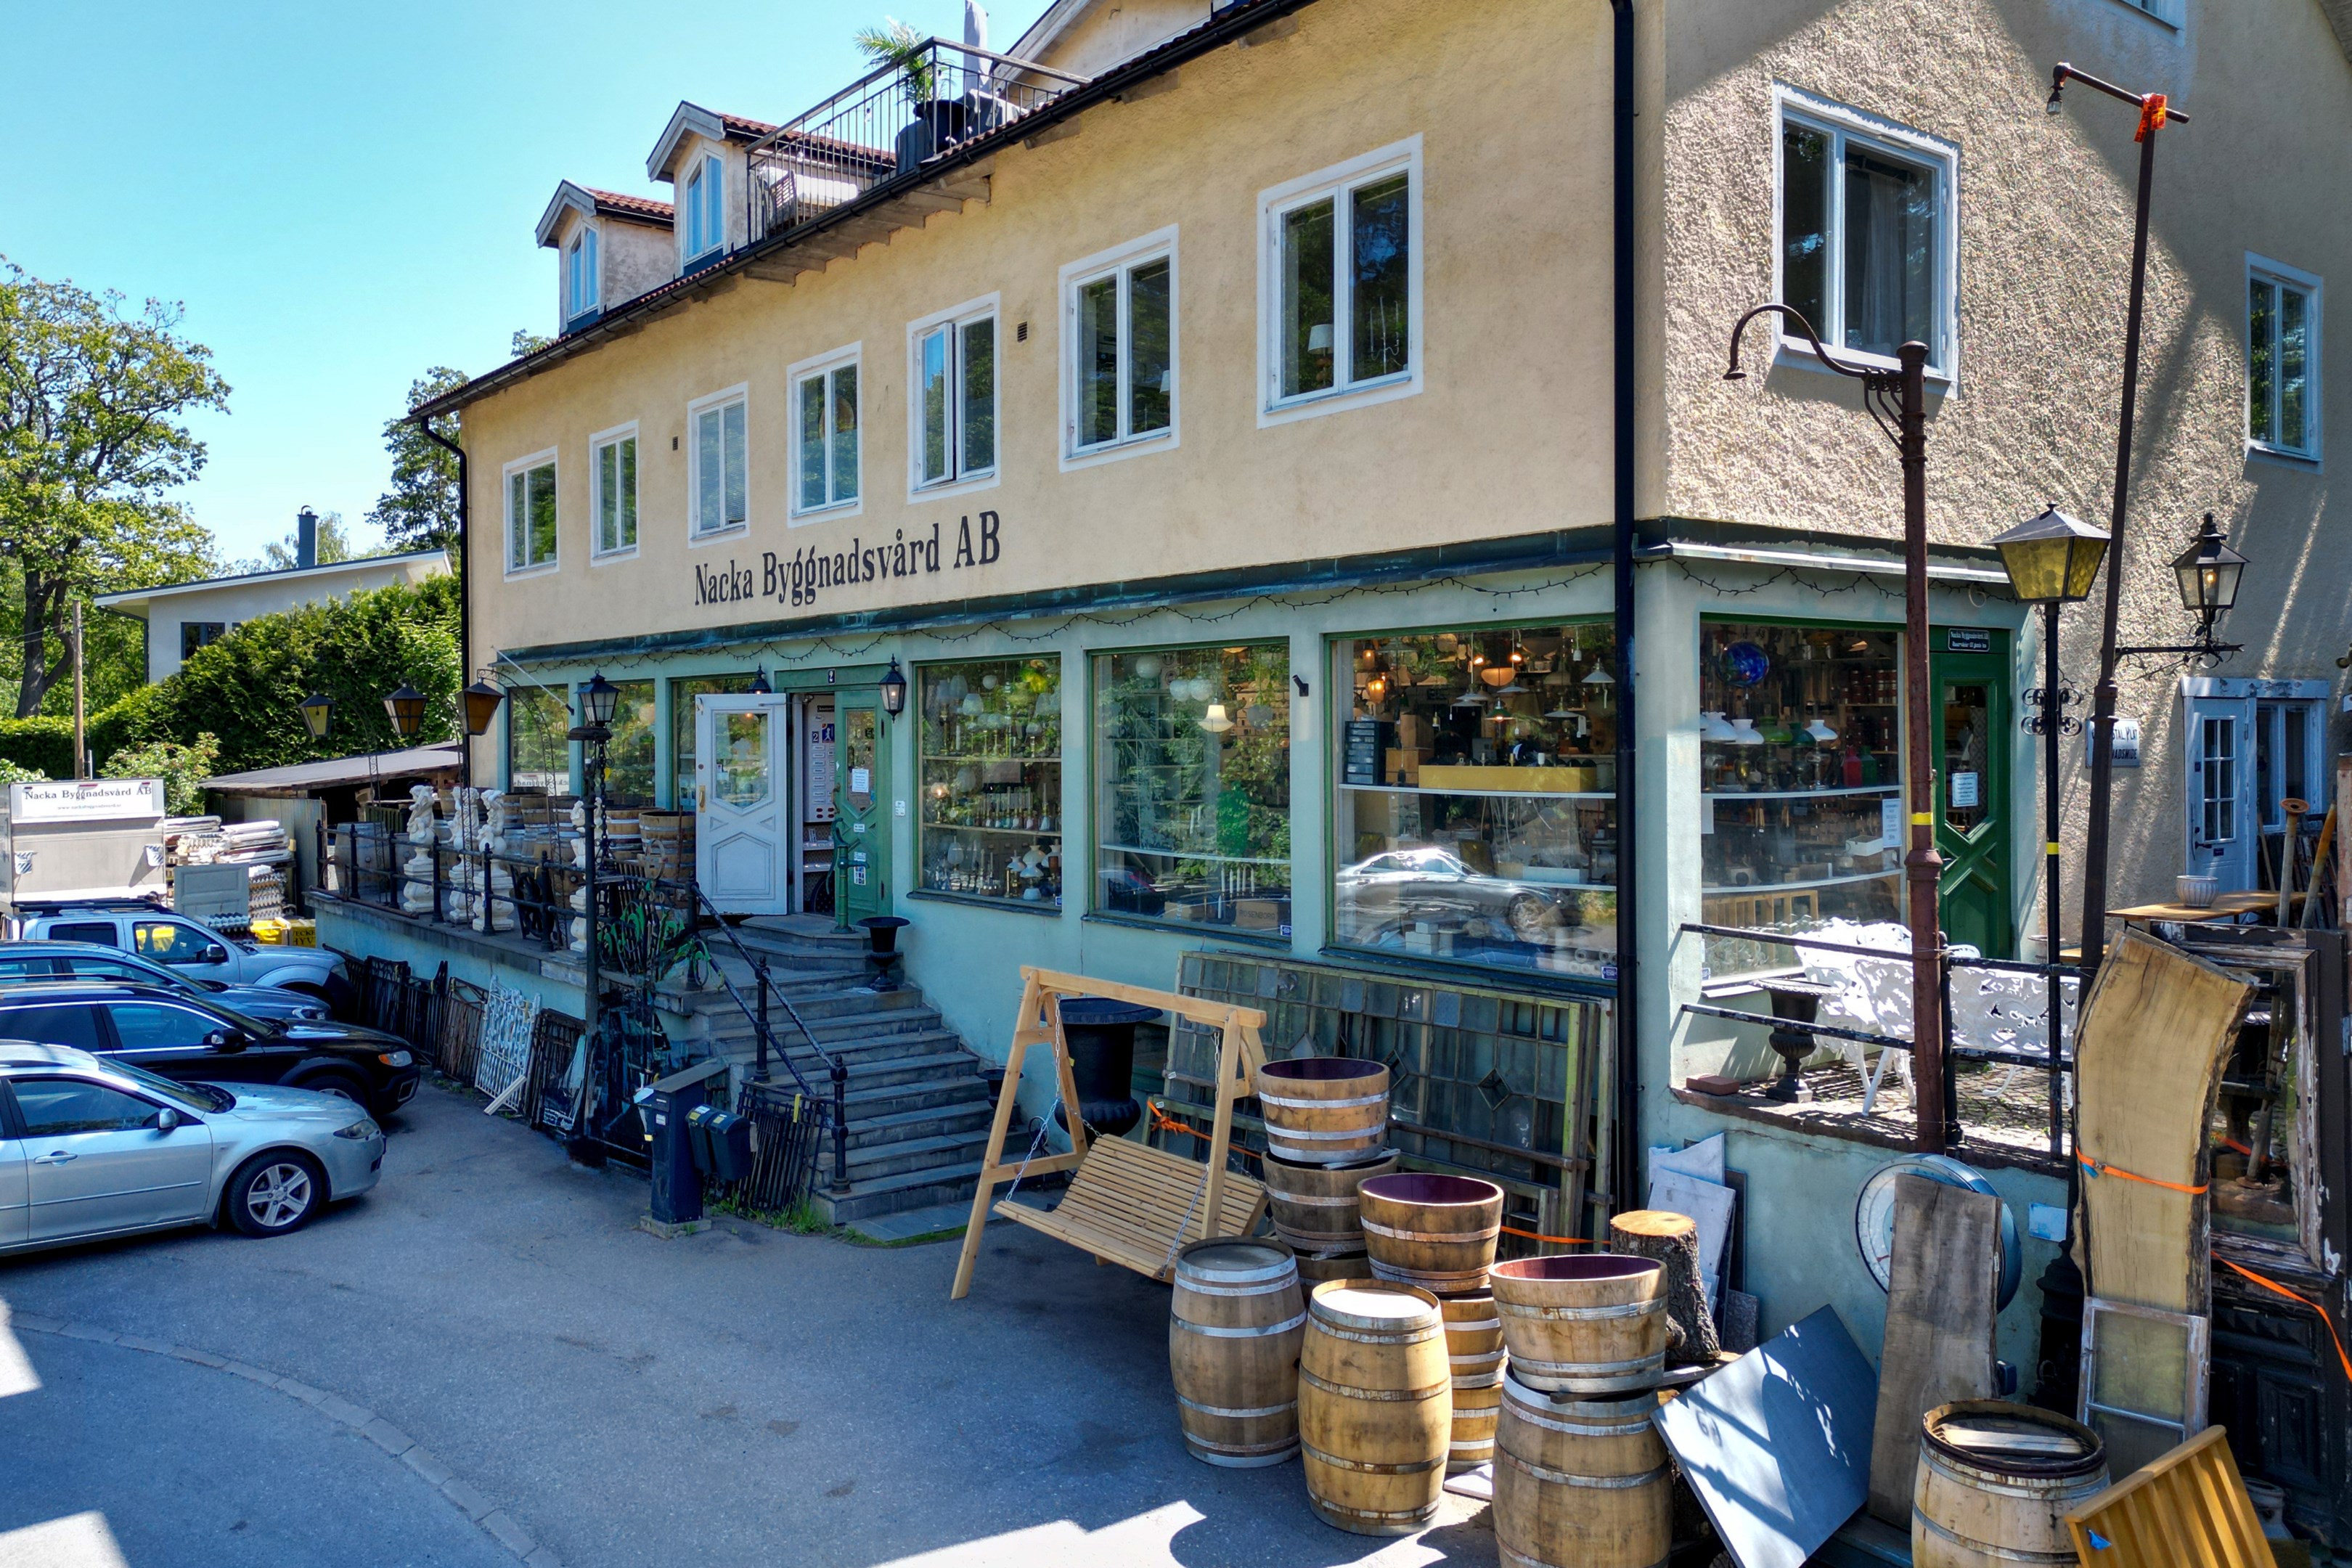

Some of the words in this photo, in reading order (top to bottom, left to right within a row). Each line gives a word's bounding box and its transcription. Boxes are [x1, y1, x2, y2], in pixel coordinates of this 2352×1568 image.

[695, 560, 754, 605] Nacka
[762, 523, 940, 607] Byggnadsvård
[954, 510, 1000, 569] AB
[813, 732, 818, 741] 2
[25, 791, 57, 800] Nacka
[62, 788, 131, 801] Byggnadsvård
[136, 787, 152, 796] AB
